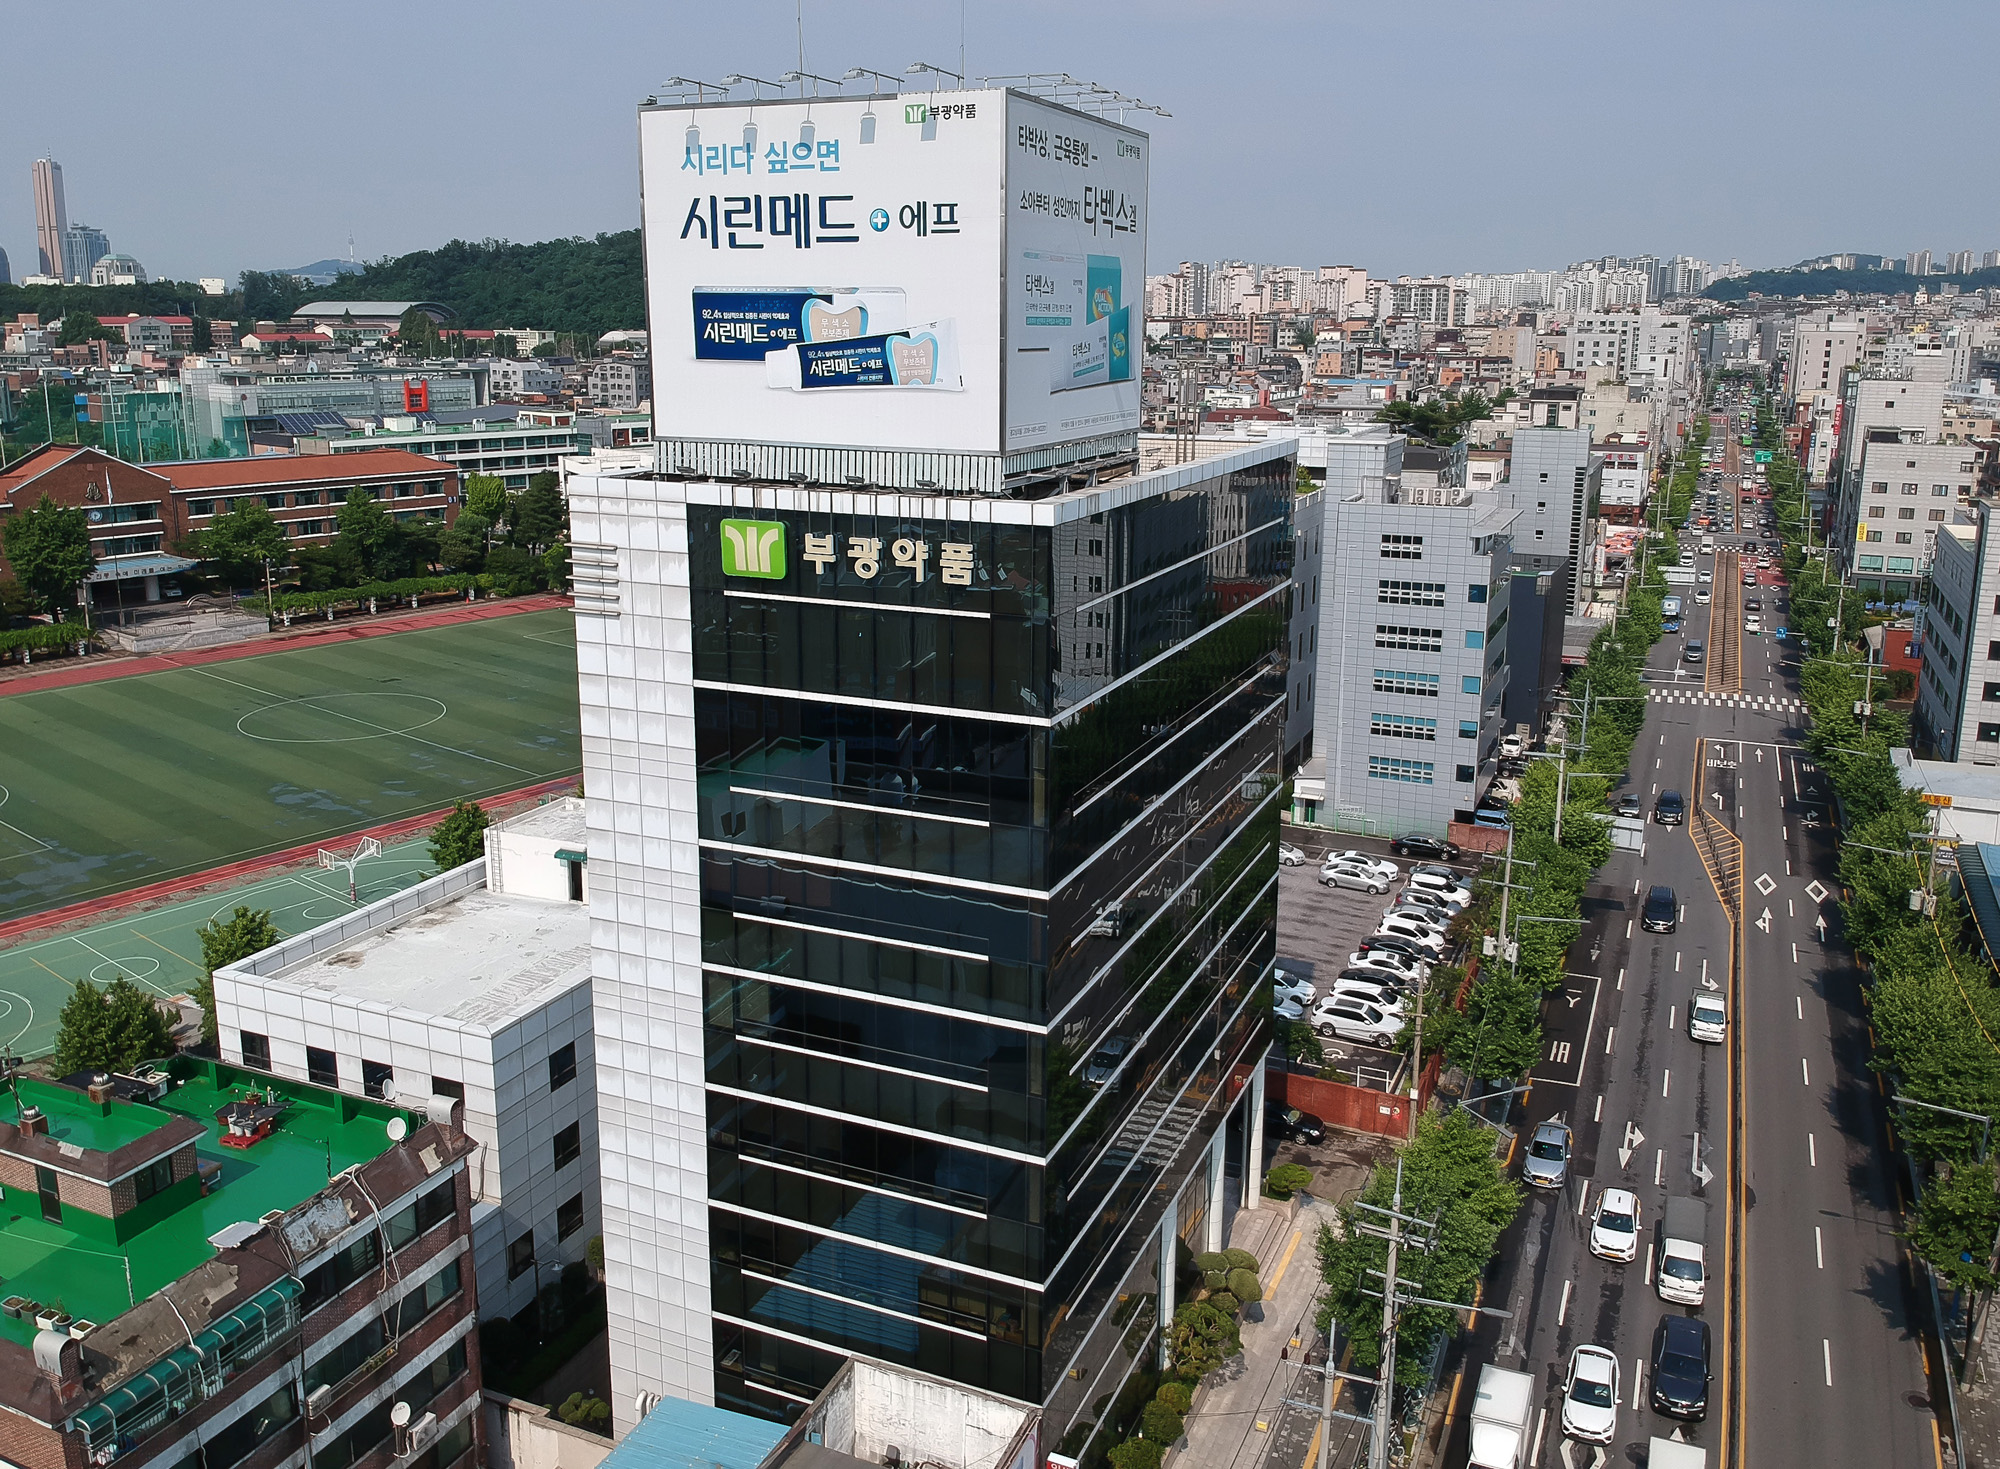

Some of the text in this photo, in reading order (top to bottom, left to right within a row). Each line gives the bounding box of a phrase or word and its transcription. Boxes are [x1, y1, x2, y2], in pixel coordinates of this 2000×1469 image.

[930, 104, 976, 120] 부광약품
[681, 140, 840, 176] 시리다 싶으면
[1018, 124, 1089, 168] 타박상, 근육통엔
[1020, 189, 1050, 215] 소아부터
[1053, 195, 1081, 221] 성인까지
[680, 193, 961, 250] 시린메드 에프
[703, 322, 798, 343] 시린메드 에프
[821, 328, 850, 338] 무보존제
[809, 357, 884, 377] 시린메드 에프
[803, 533, 976, 586] 부광약품
[1706, 758, 1737, 770] 비보호
